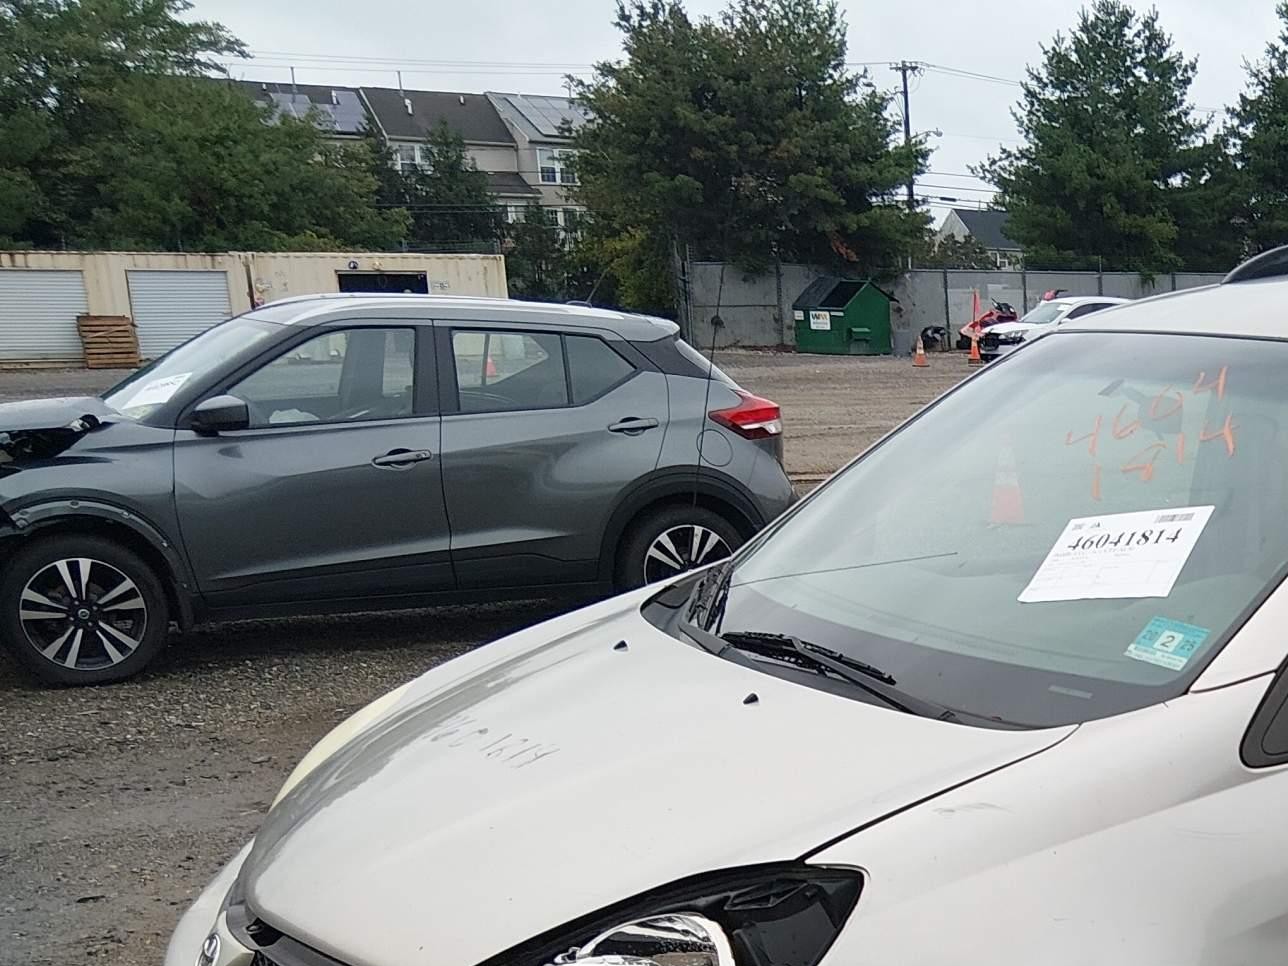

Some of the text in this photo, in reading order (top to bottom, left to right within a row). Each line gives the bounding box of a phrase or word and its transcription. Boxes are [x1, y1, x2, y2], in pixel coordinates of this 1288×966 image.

[1064, 365, 1227, 457] 4604
[1067, 527, 1183, 551] 46041814
[1160, 635, 1176, 648] 2
